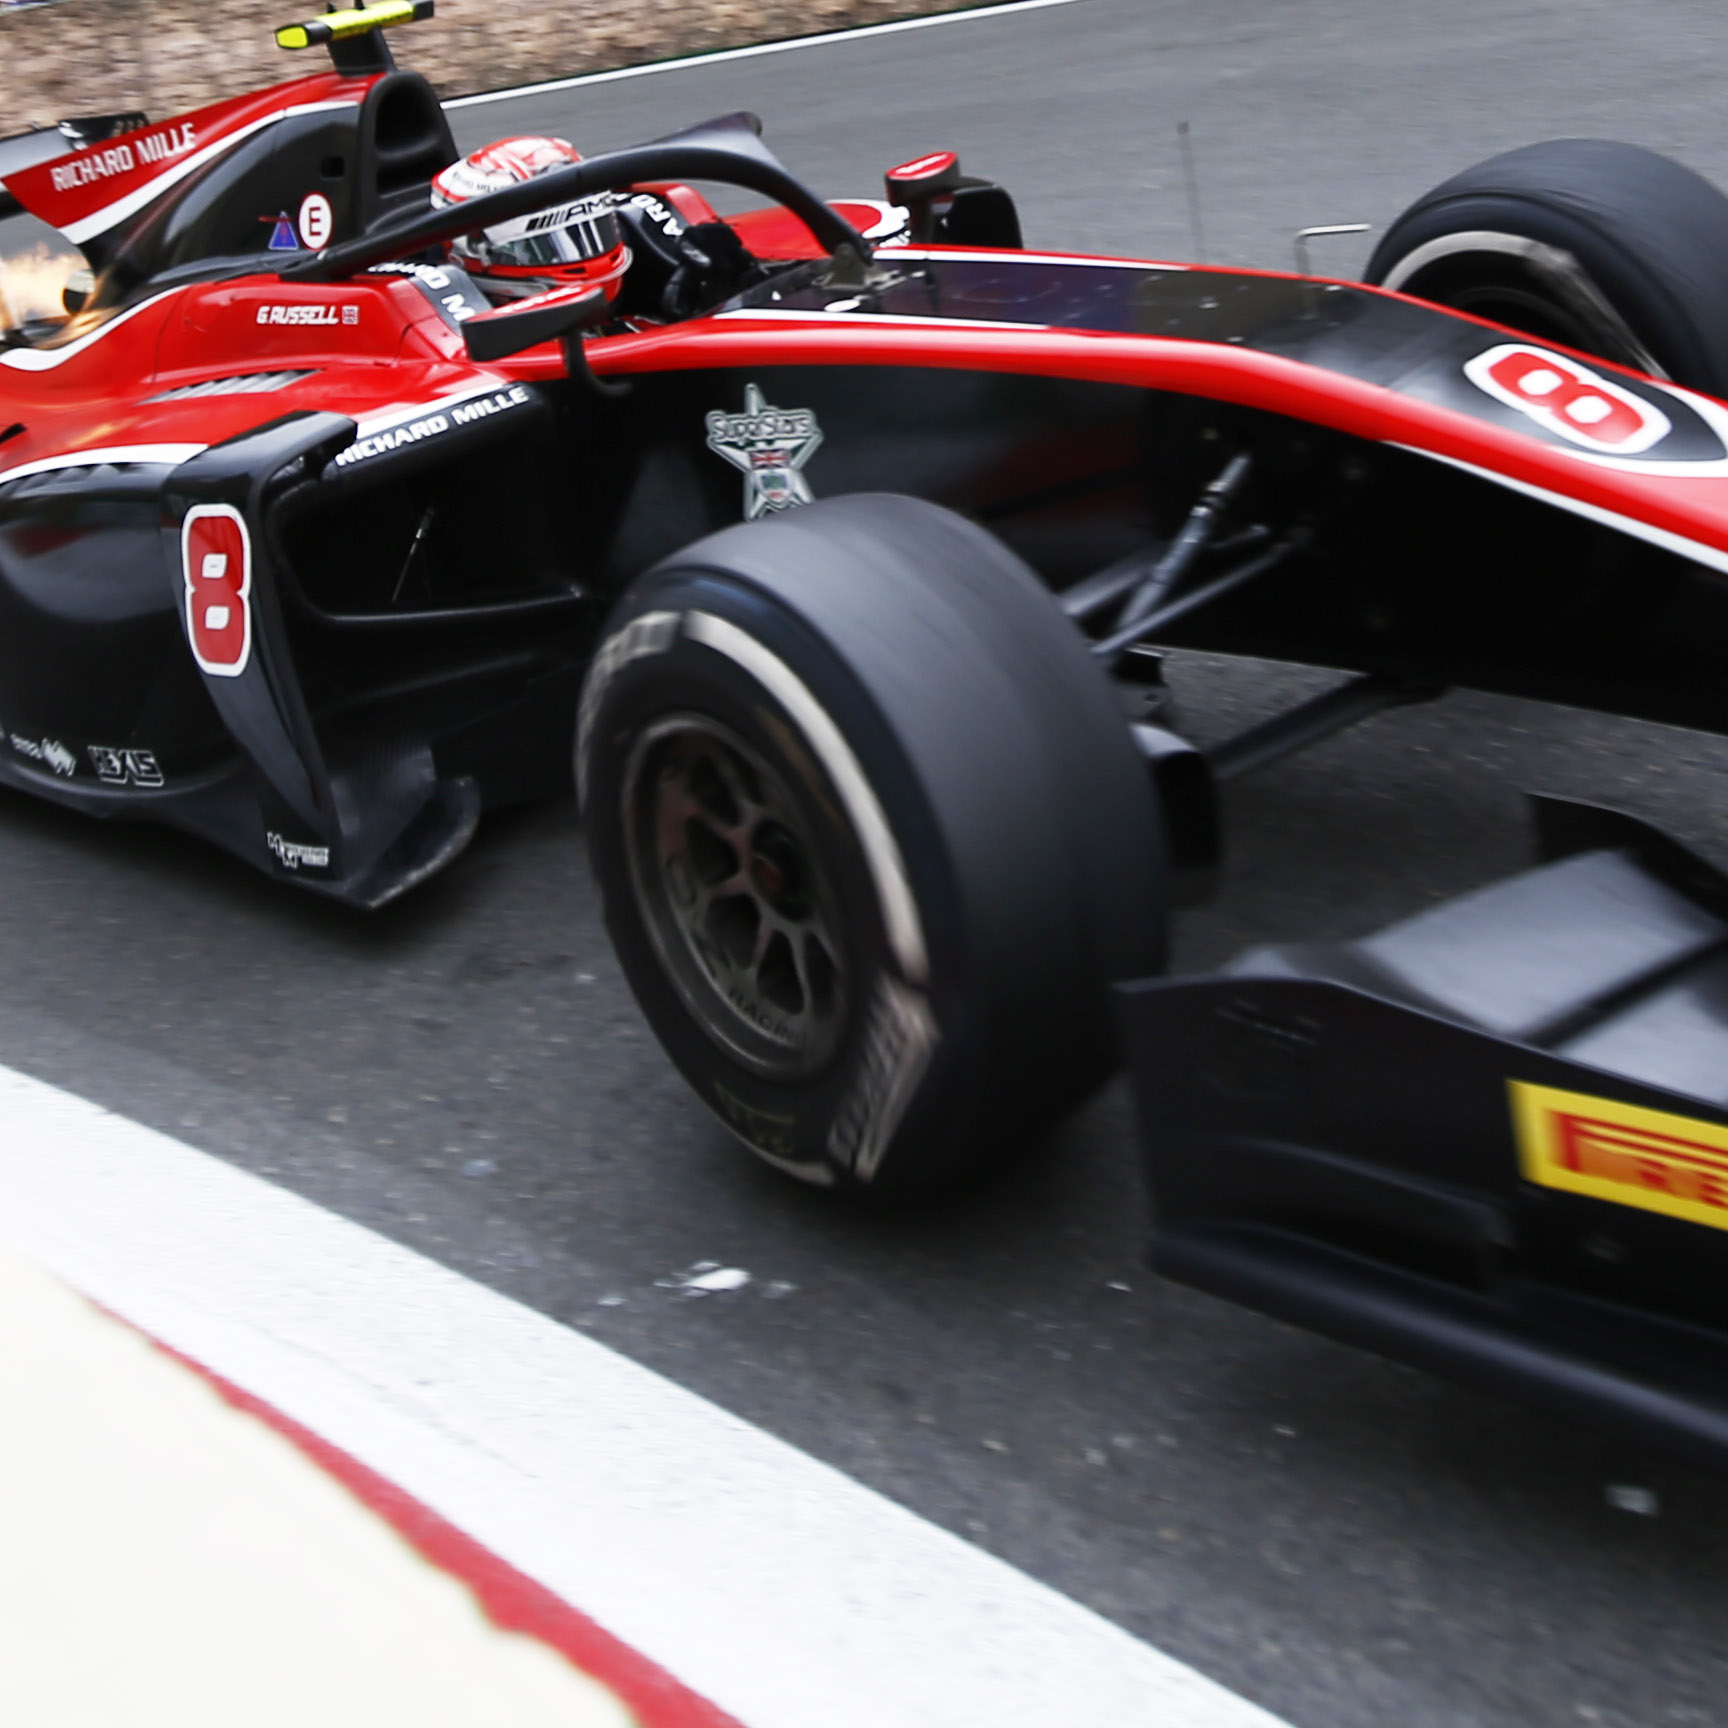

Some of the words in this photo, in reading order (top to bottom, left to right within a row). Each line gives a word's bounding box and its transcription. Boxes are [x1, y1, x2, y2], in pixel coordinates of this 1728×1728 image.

[50, 145, 134, 192] RICHARD
[134, 122, 196, 165] MILLE
[309, 207, 322, 236] E
[451, 386, 530, 426] MILLE
[1464, 344, 1672, 454] 8
[183, 505, 250, 674] 8
